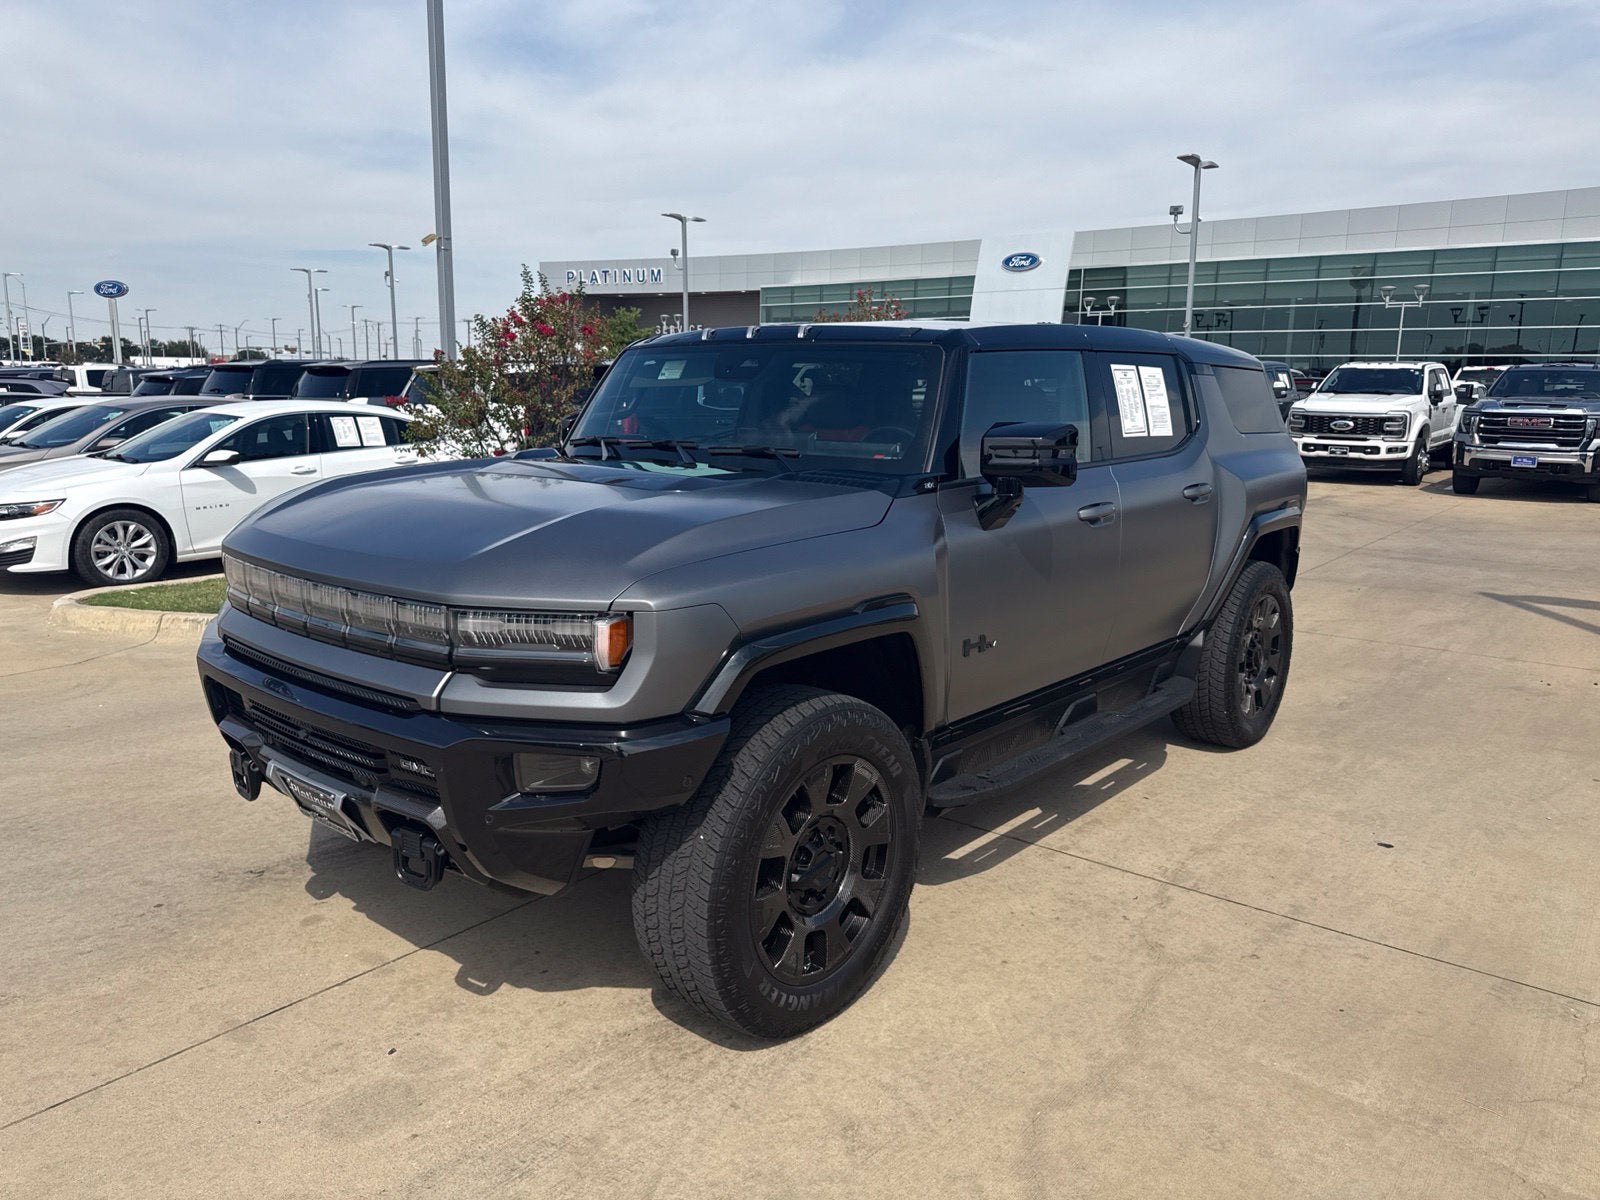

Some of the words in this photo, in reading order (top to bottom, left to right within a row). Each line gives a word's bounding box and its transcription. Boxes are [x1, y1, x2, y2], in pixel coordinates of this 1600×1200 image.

[1009, 255, 1032, 267] Ford
[565, 268, 663, 284] PLATINUM
[100, 283, 118, 294] Ford
[655, 324, 703, 334] SERVCE
[400, 758, 436, 778] GMC
[758, 977, 840, 1012] ANGLER
